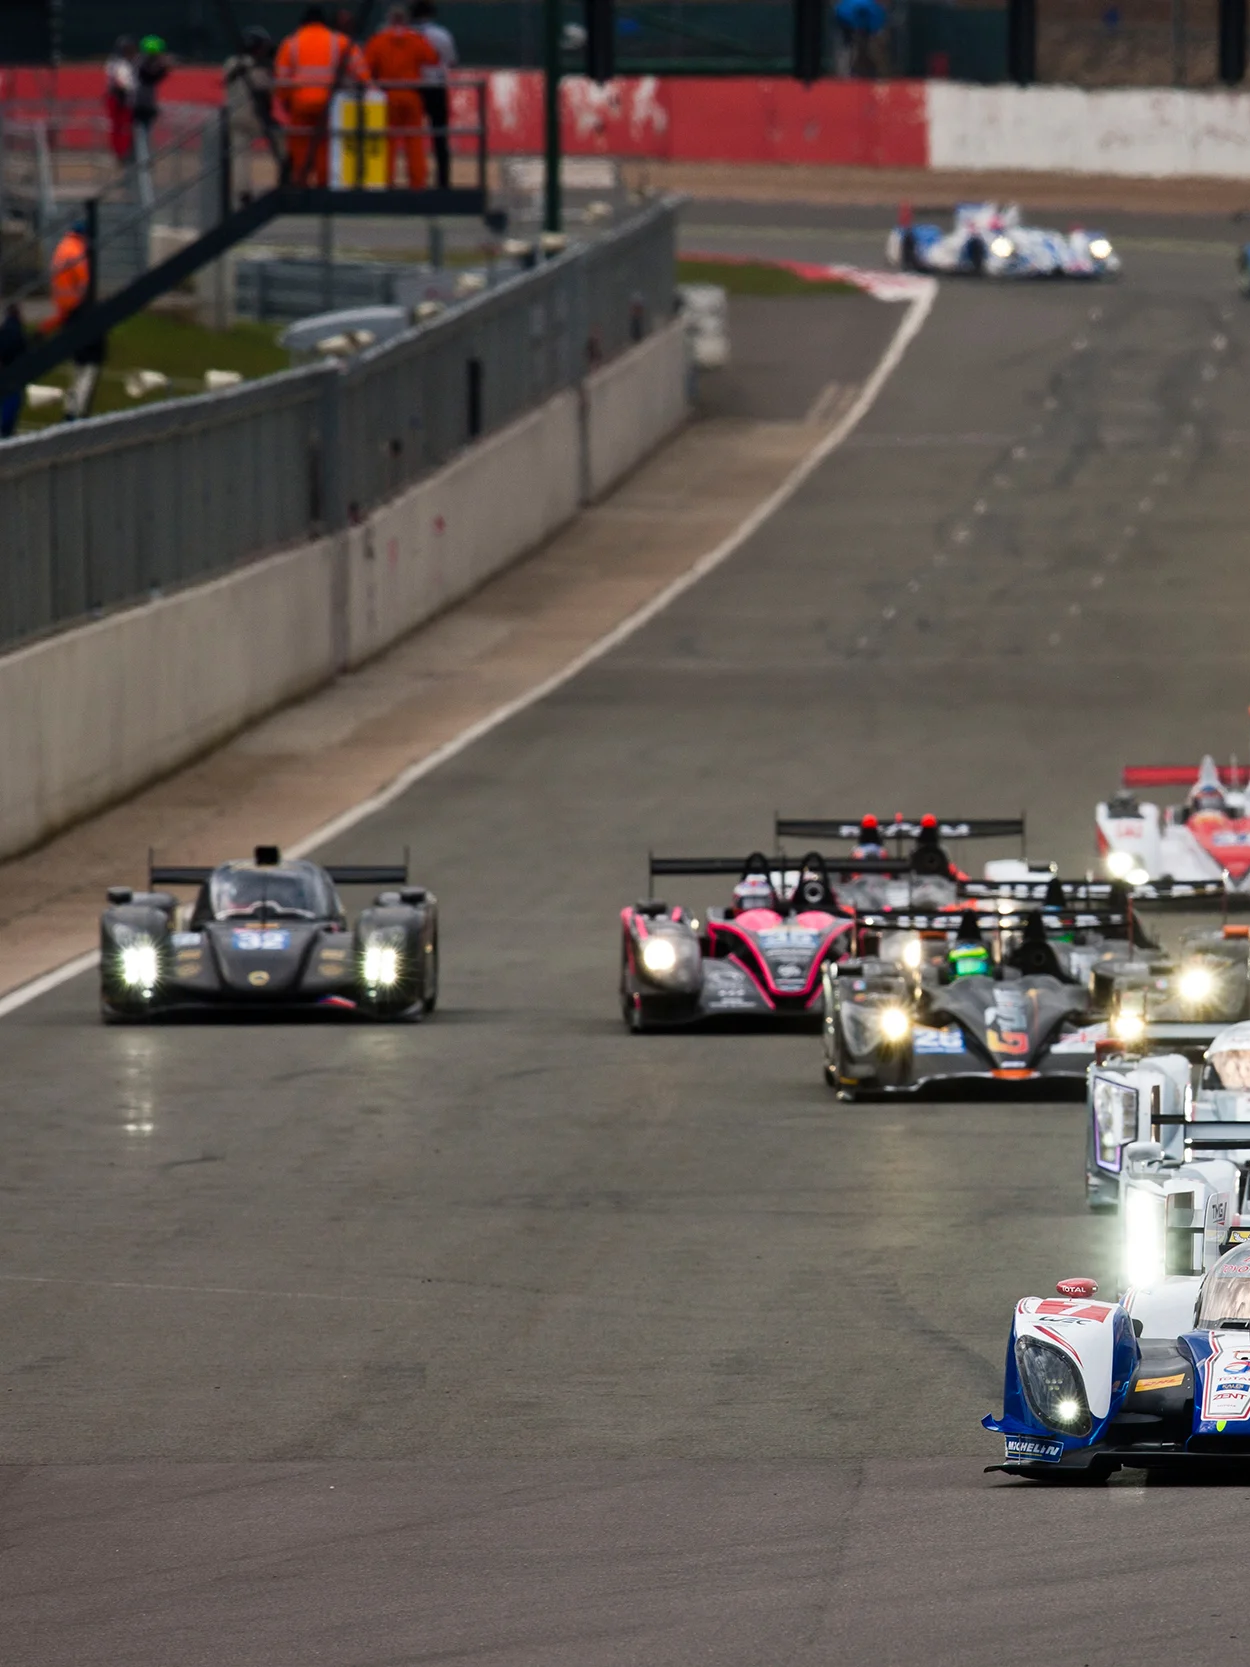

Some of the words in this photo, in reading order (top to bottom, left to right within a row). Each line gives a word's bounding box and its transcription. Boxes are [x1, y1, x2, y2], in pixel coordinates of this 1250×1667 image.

[1061, 1285, 1086, 1293] TOTAL
[1058, 1301, 1093, 1315] 7
[1213, 1392, 1248, 1401] ZENT
[1008, 1441, 1060, 1456] MICHELIN
